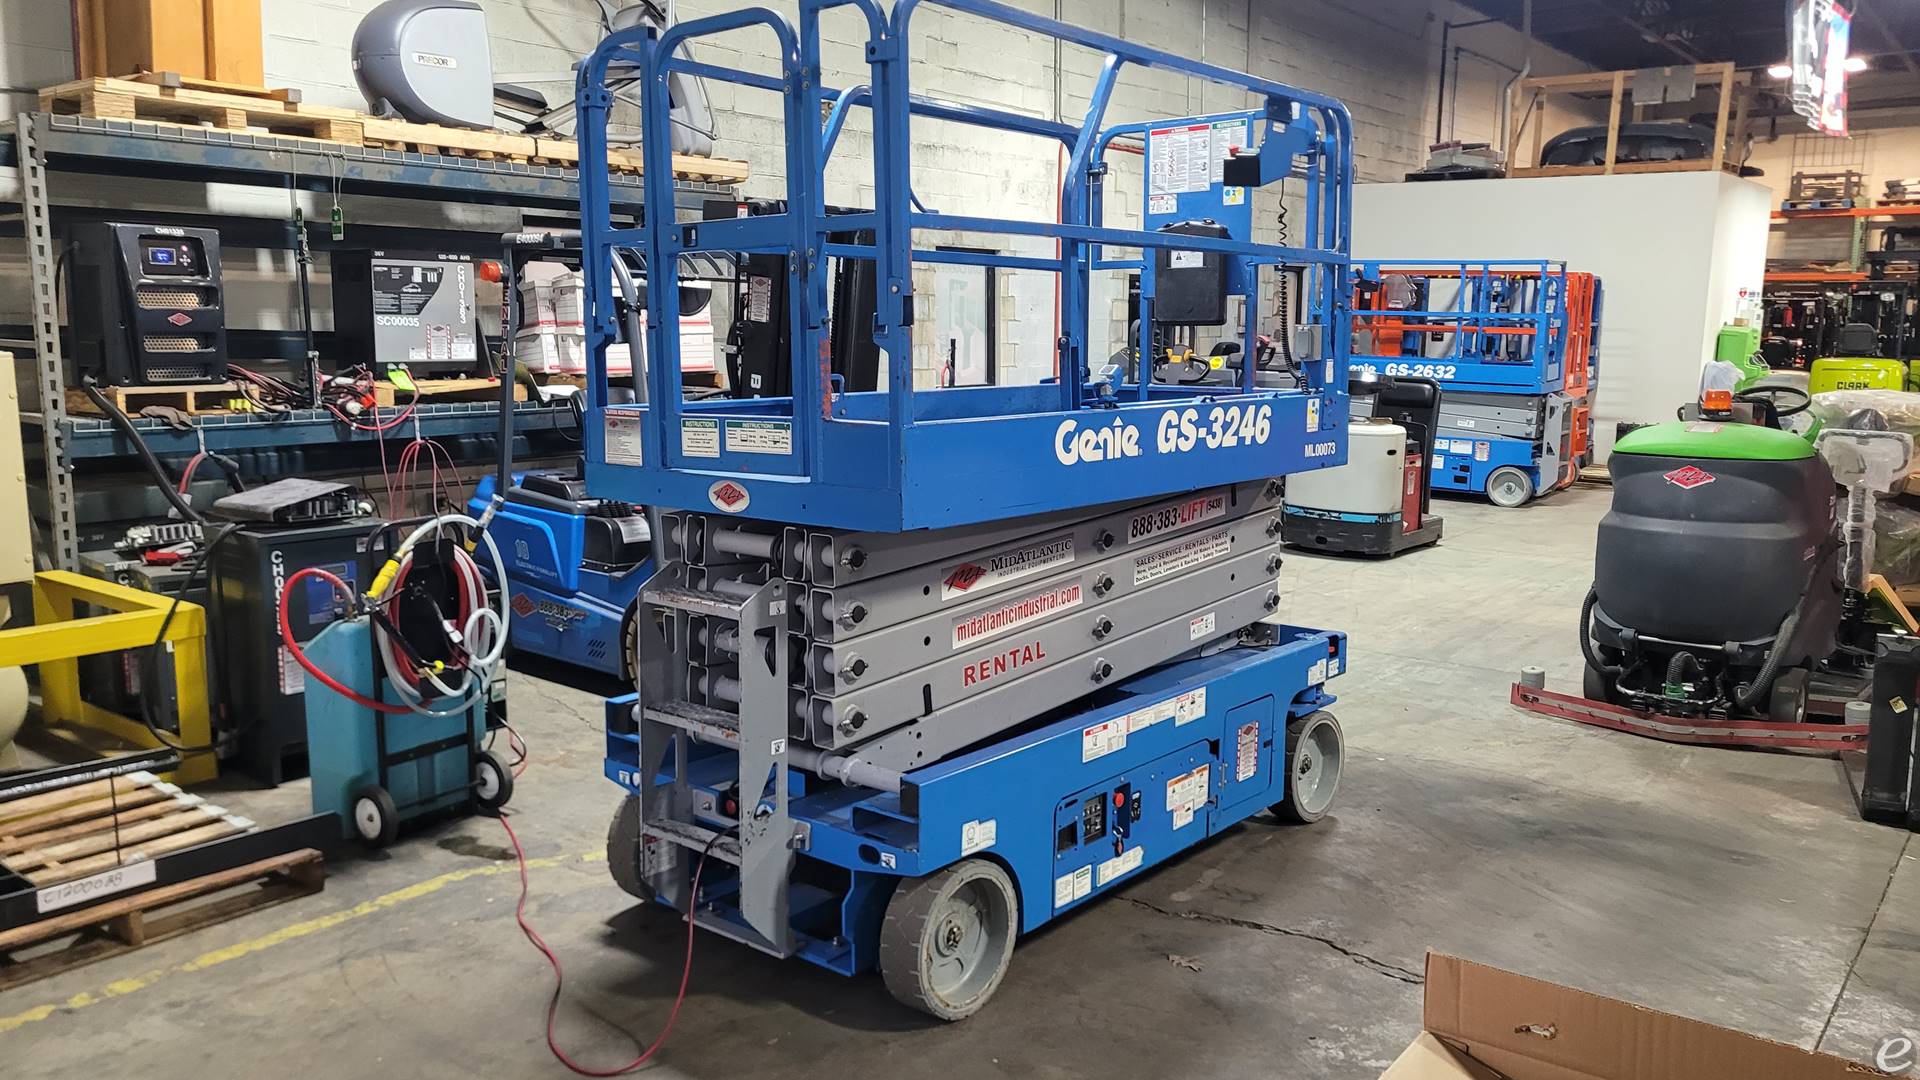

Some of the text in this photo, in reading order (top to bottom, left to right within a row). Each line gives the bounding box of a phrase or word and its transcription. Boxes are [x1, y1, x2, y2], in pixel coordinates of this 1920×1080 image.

[417, 55, 449, 66] PRECOR
[501, 282, 511, 374] ENTAL
[1385, 363, 1456, 379] GS-2632
[1836, 381, 1869, 390] CLARK
[1055, 405, 1272, 465] Genie GS-3246
[1304, 442, 1336, 458] ML00073
[998, 566, 1027, 578] INDUSTRIAL
[1027, 557, 1056, 571] EQUIPMENT
[1162, 553, 1189, 566] Reconditioned
[957, 585, 1080, 641] midatlanticindustrial.com
[963, 641, 1046, 687] RENTAL
